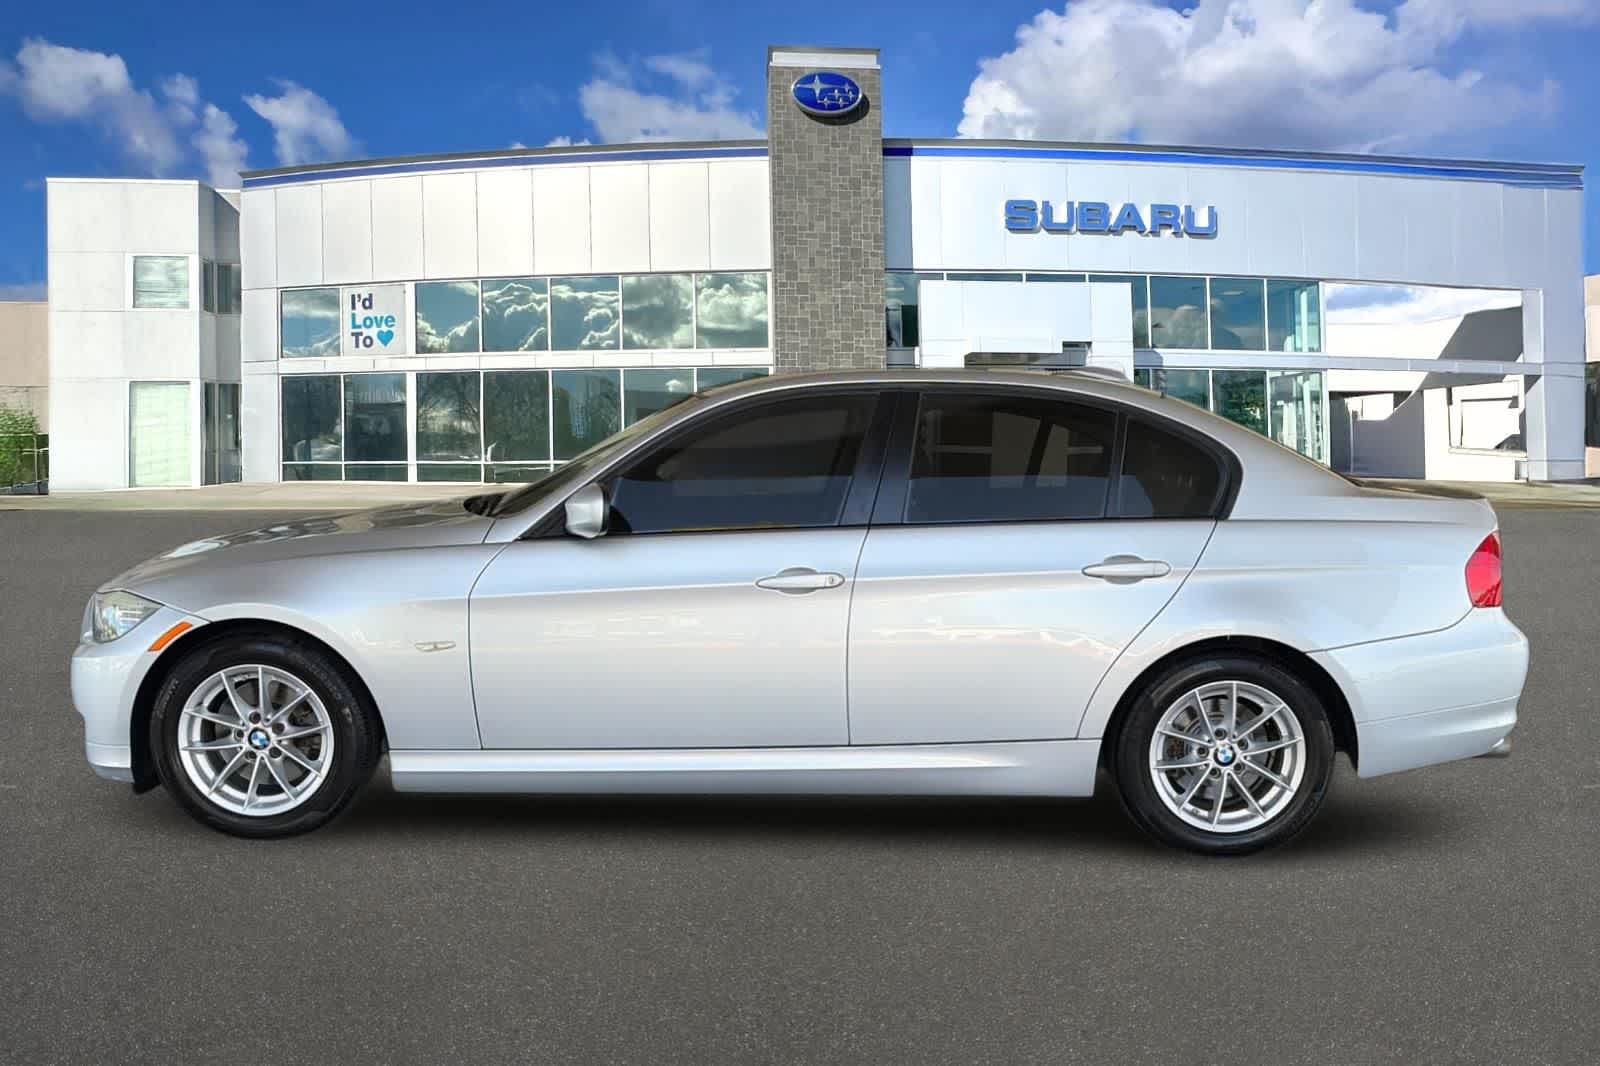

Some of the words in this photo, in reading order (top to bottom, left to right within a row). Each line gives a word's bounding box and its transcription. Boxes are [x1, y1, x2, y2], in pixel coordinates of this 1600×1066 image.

[1005, 199, 1217, 237] SUBARU
[351, 293, 373, 310] I'd
[351, 312, 396, 329] Love
[351, 332, 373, 348] To
